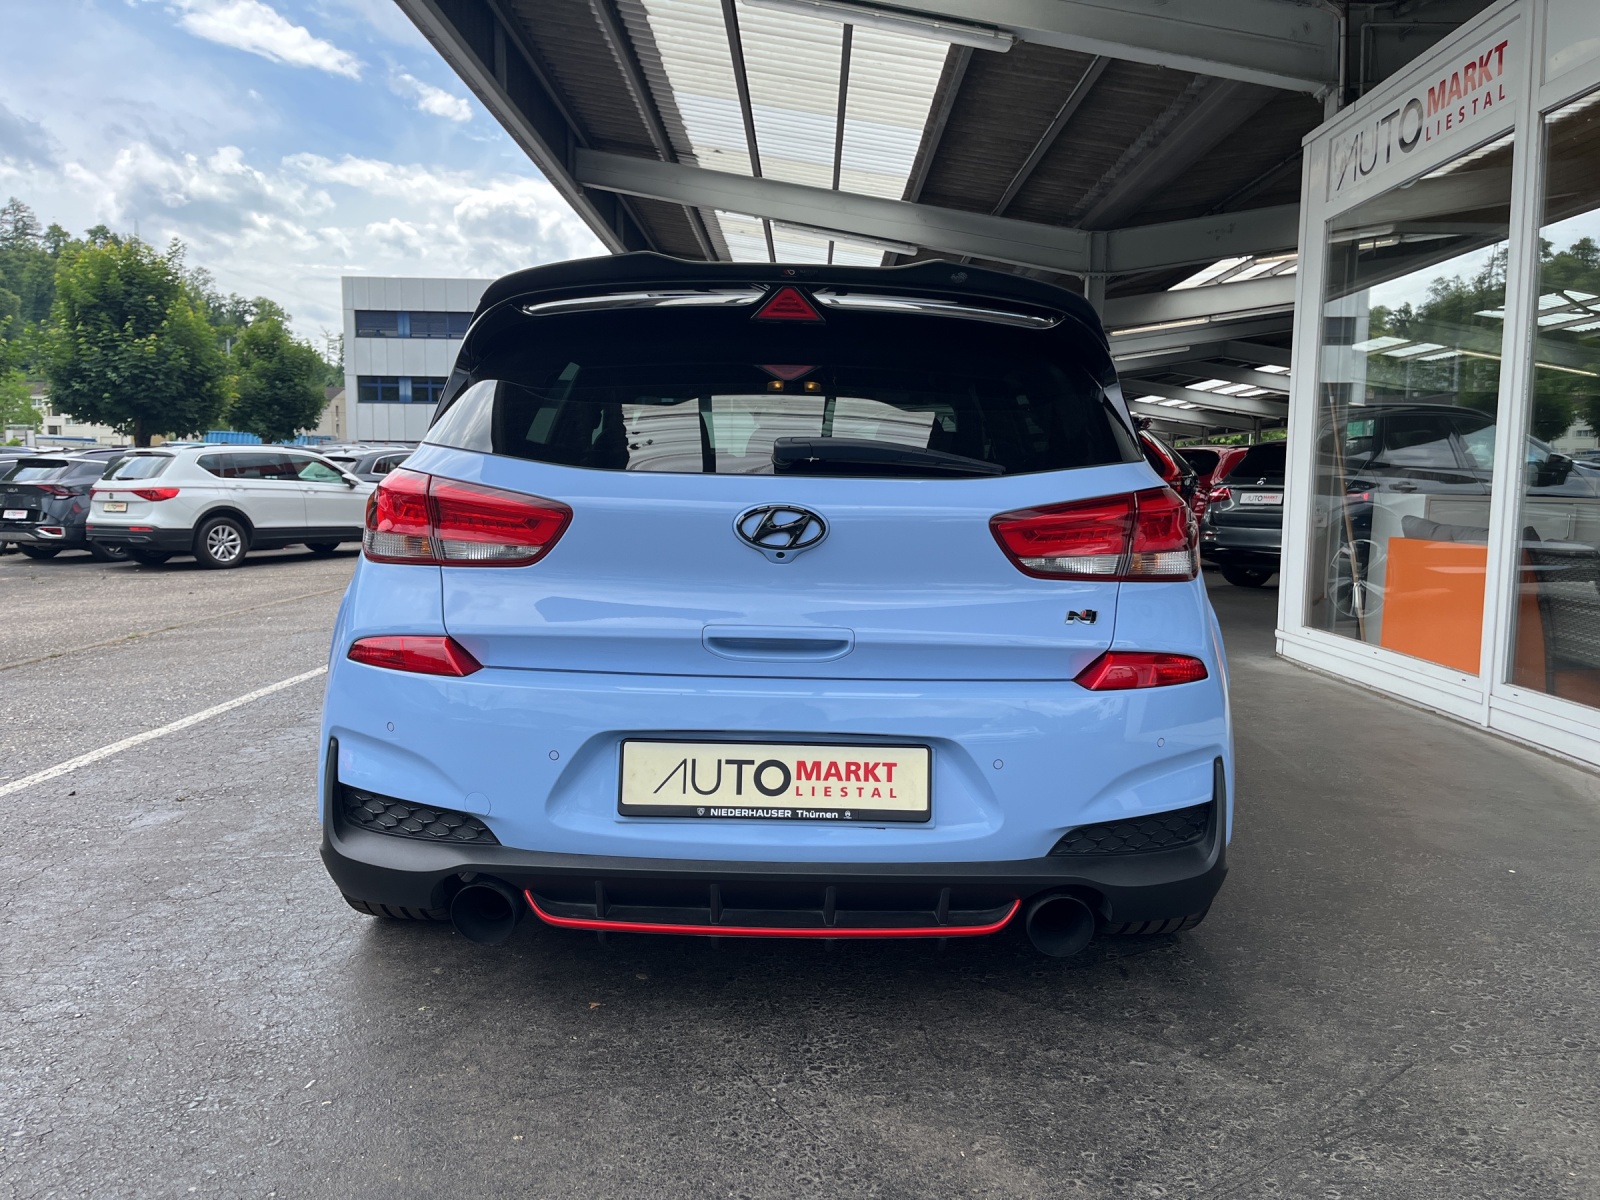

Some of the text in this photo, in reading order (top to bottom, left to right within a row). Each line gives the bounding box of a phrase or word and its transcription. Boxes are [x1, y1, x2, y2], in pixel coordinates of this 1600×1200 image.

[1336, 39, 1508, 191] AUTO MARKT
[1425, 84, 1506, 142] LIESTAL
[653, 758, 898, 797] AUTO MARKT
[795, 786, 898, 798] LIESTAL
[710, 808, 839, 819] NIEDERHAUSER Thürnen
